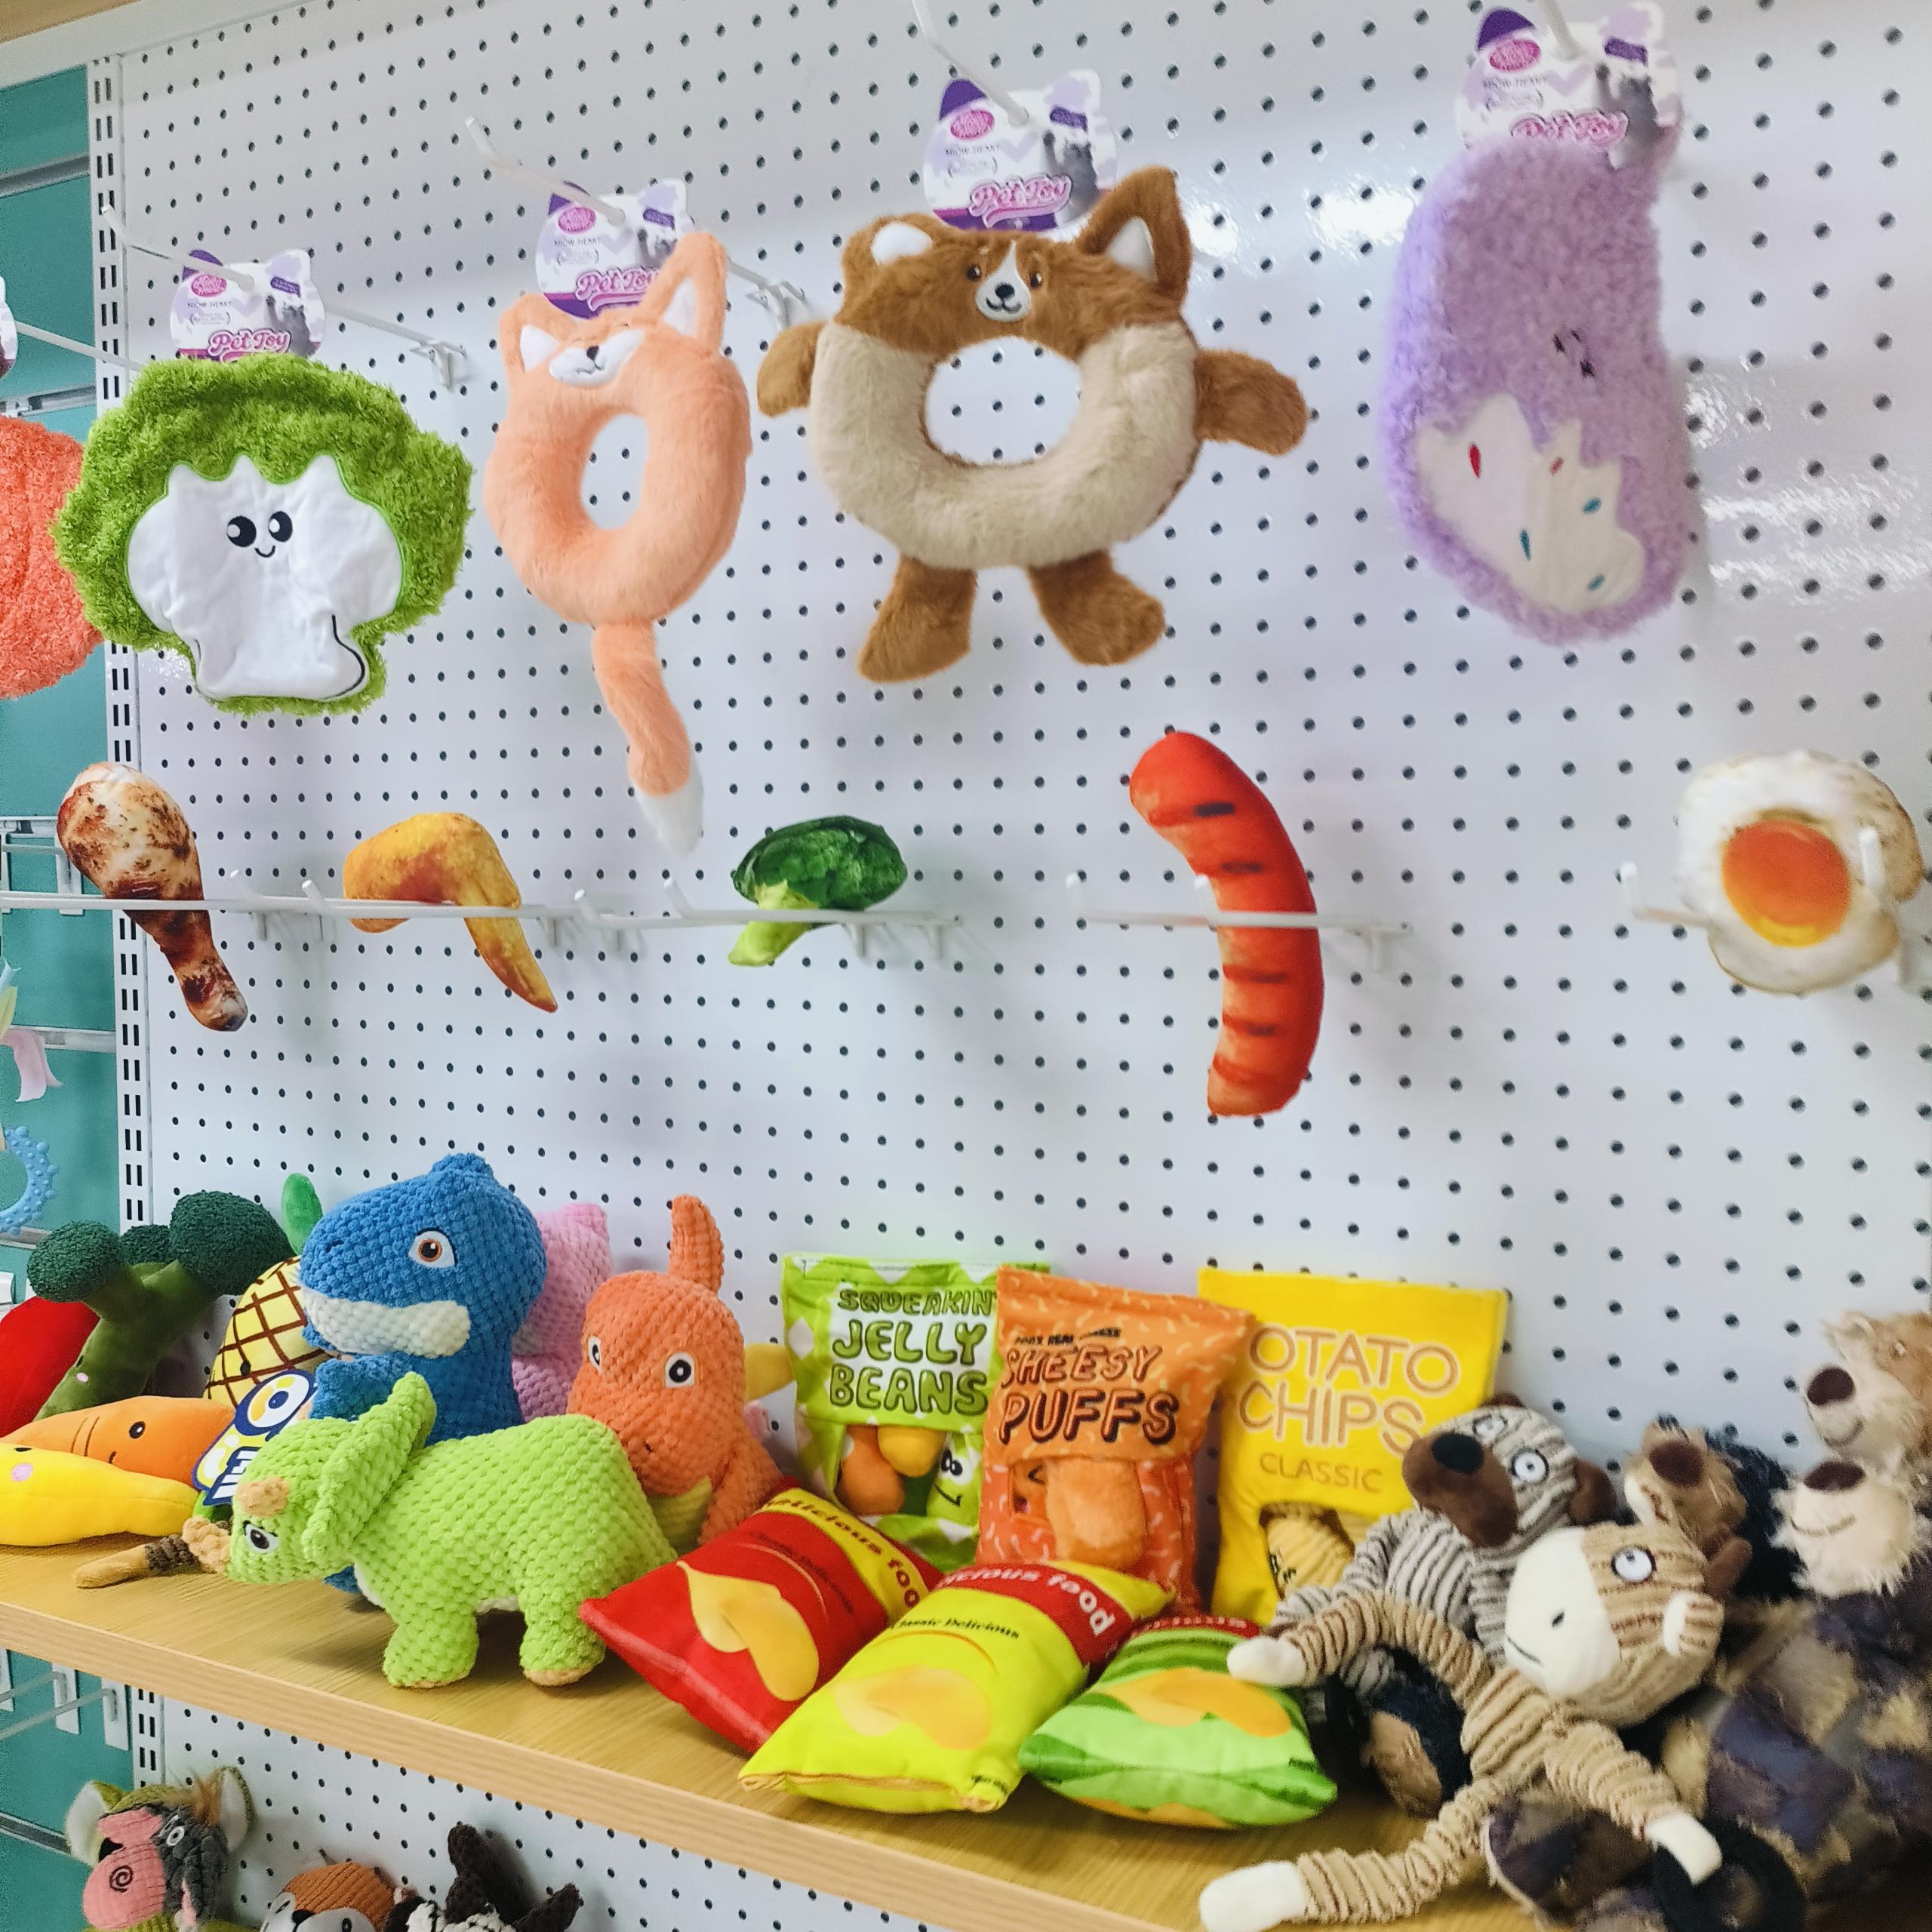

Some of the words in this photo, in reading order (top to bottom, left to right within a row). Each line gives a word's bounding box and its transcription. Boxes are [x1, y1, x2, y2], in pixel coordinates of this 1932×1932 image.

[832, 1319, 987, 1366] JELLY
[1247, 1325, 1460, 1396] OTATO
[830, 1363, 989, 1416] BEANS
[998, 1387, 1180, 1444] PUFFS
[1238, 1380, 1425, 1457] CHIPS
[1259, 1452, 1383, 1494] CLASSIC
